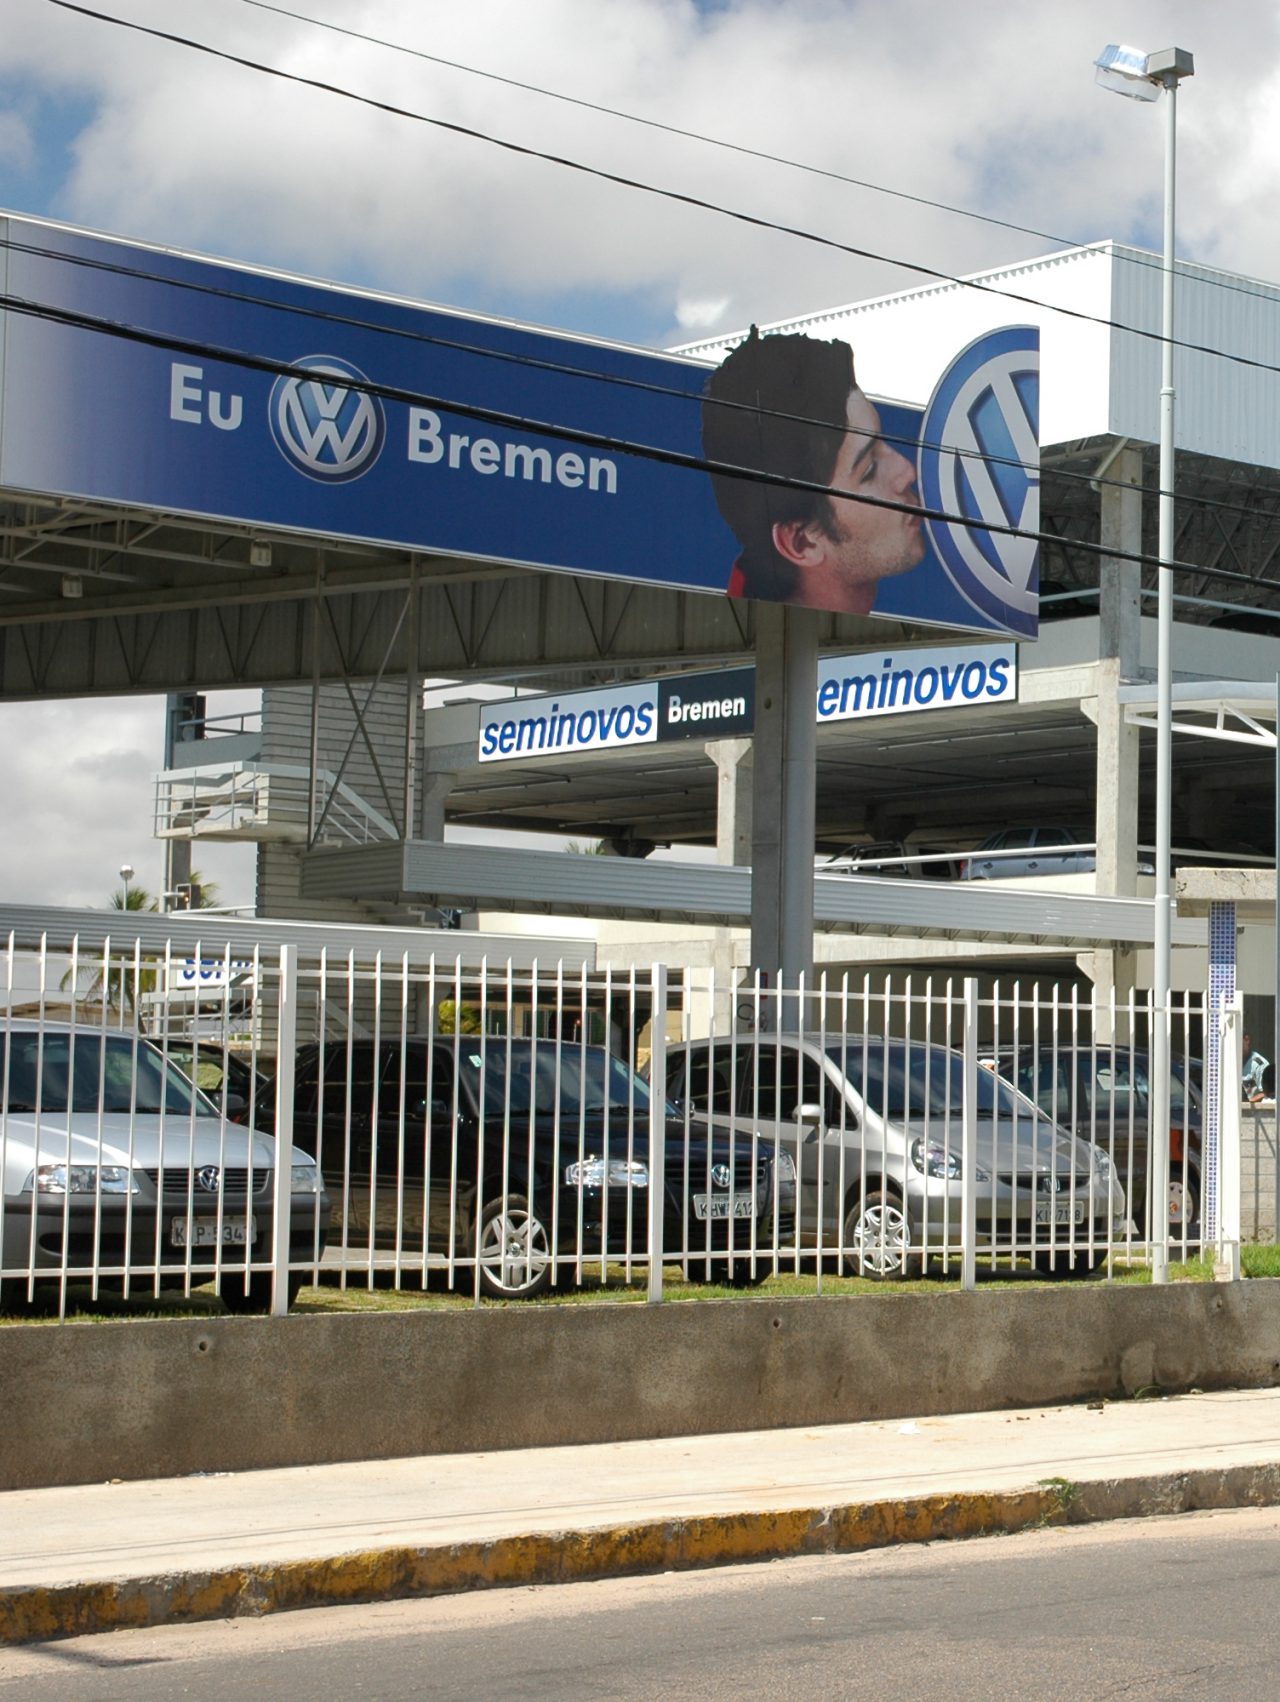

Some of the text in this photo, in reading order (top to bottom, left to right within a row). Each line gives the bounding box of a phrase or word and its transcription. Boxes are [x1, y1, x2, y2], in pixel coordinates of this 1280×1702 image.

[171, 362, 243, 431] Eu
[408, 406, 617, 494] Bremen
[482, 658, 1010, 755] seminovos Bremen eminovos
